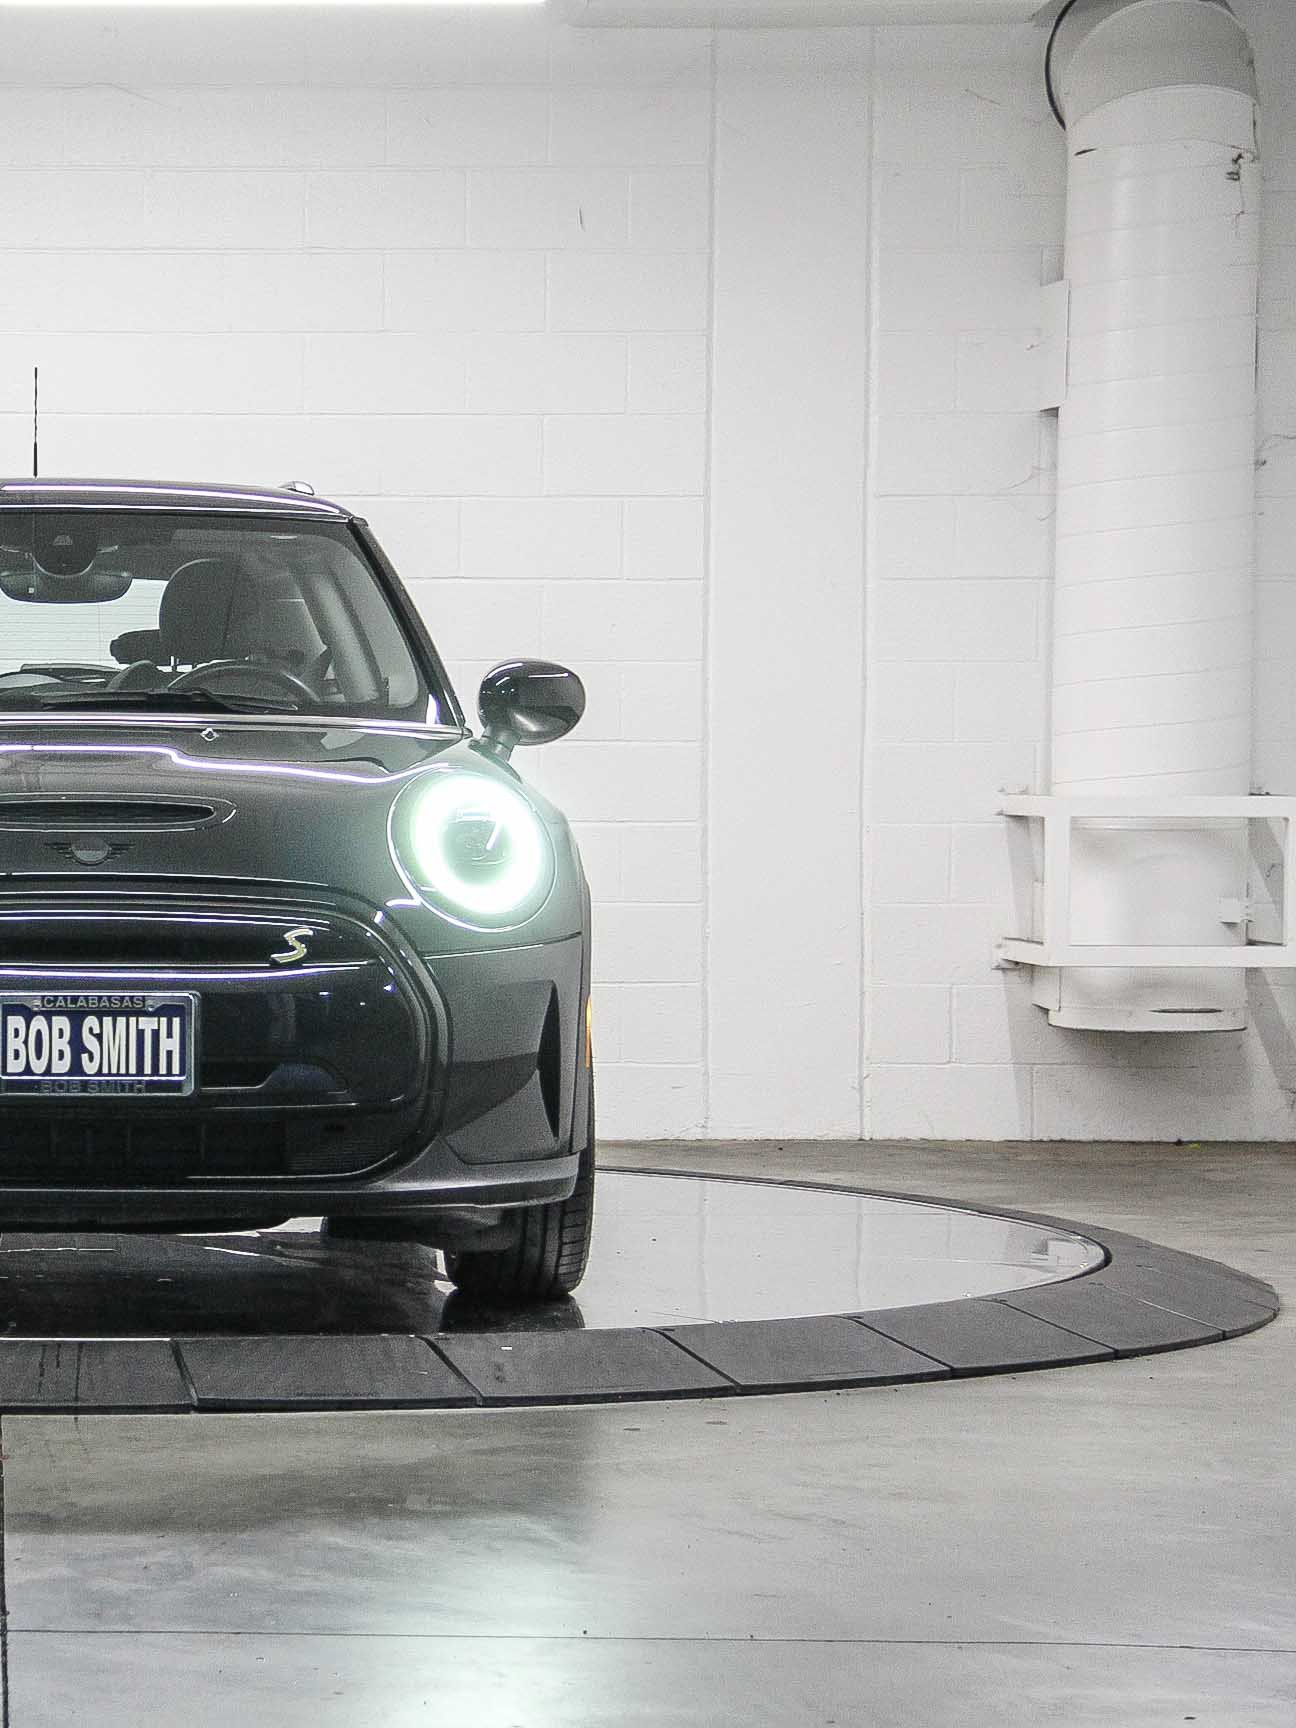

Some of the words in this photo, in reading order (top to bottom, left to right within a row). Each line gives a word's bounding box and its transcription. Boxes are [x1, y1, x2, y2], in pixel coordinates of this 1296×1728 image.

[270, 928, 314, 963] S
[43, 996, 144, 1008] CALABASAS
[6, 1015, 72, 1074] BOB
[81, 1015, 180, 1075] SMITH
[40, 1080, 81, 1093] BOB
[87, 1080, 146, 1093] SMITH
